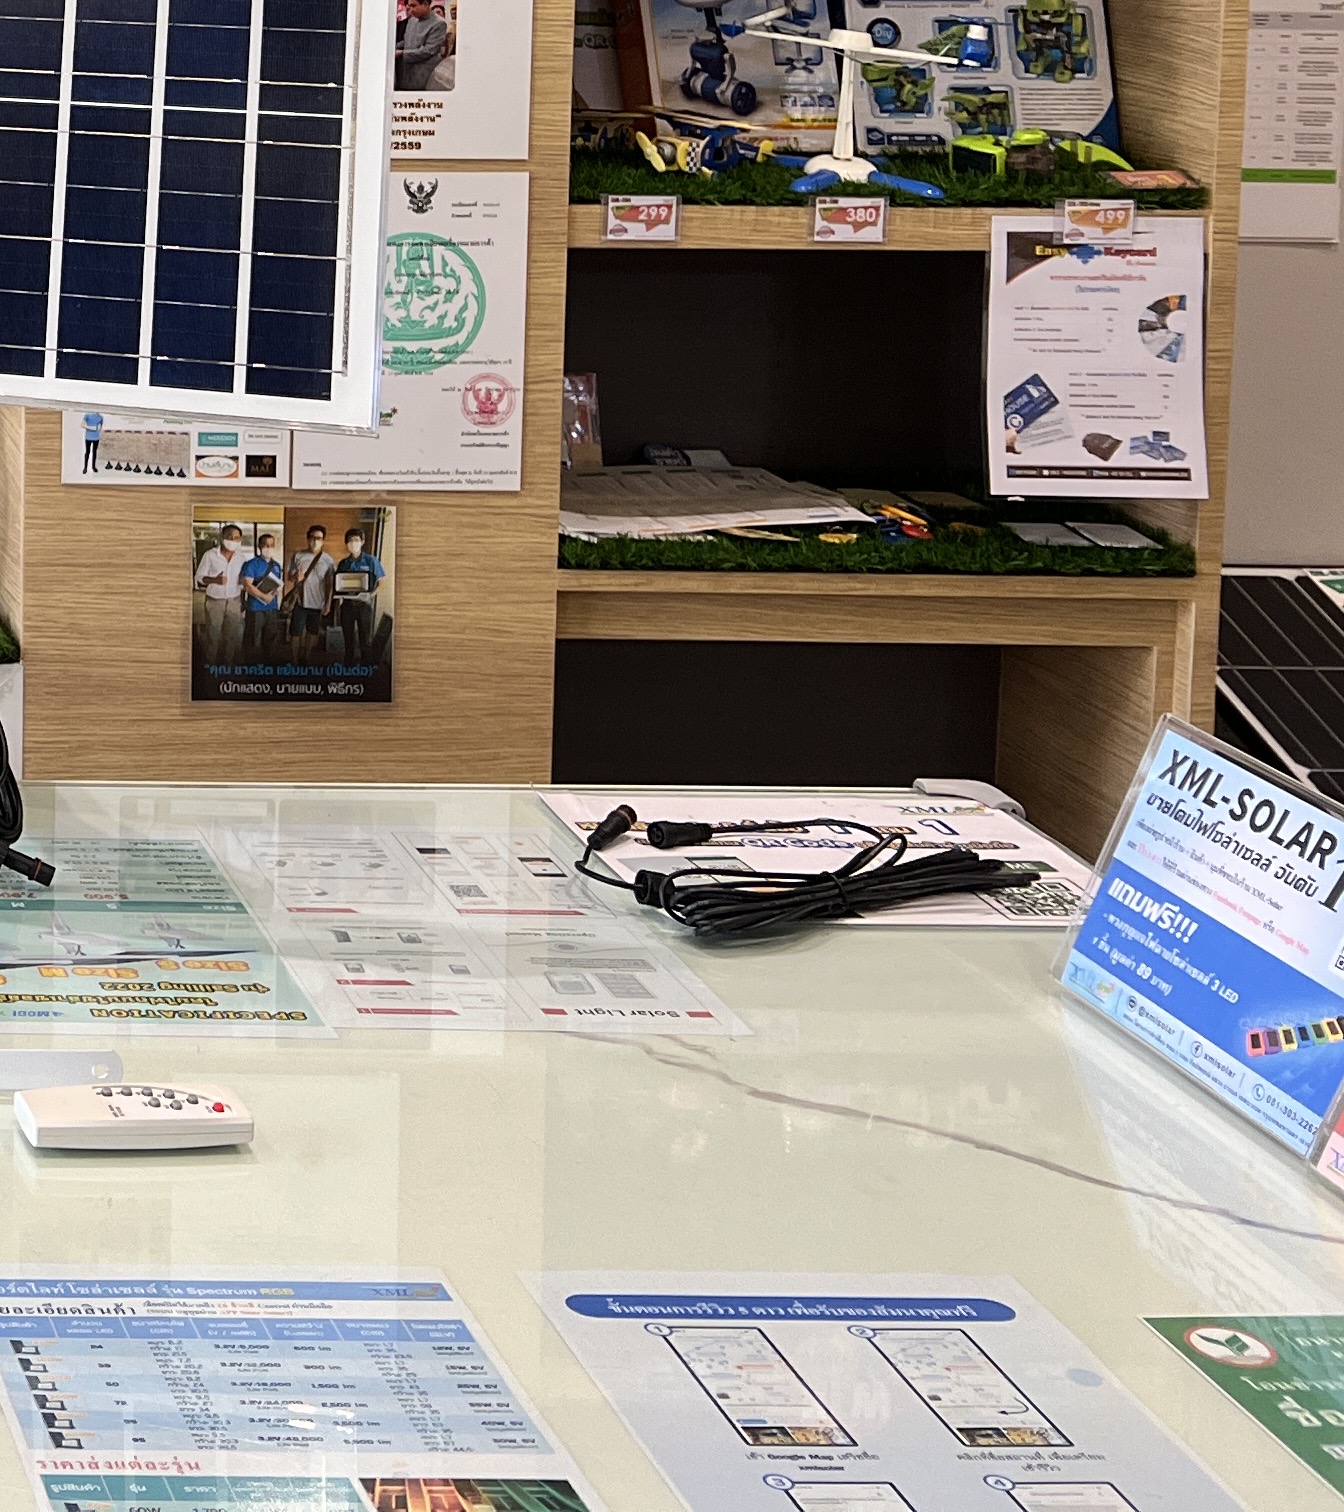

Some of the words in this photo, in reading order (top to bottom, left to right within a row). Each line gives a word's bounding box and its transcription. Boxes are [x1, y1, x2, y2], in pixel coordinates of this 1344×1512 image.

[638, 207, 668, 221] 299
[845, 208, 876, 223] 380
[1095, 209, 1126, 225] 499
[1158, 749, 1339, 871] XML-SOLAR
[1146, 791, 1279, 873] ขายโคมไฟโซล่าเซลล์
[1274, 862, 1320, 899] อันดับ
[1108, 876, 1199, 944] แถมฟรี!!!
[37, 966, 69, 978] M
[1136, 963, 1154, 981] 89
[100, 982, 155, 992] 2022
[12, 1010, 50, 1018] MODI
[89, 1008, 308, 1021] SPECIFICATION
[625, 1009, 680, 1019] Solar
[185, 1287, 257, 1297] Spectrum
[35, 1455, 200, 1475] ราคาส่งแต่ละรุ่น
